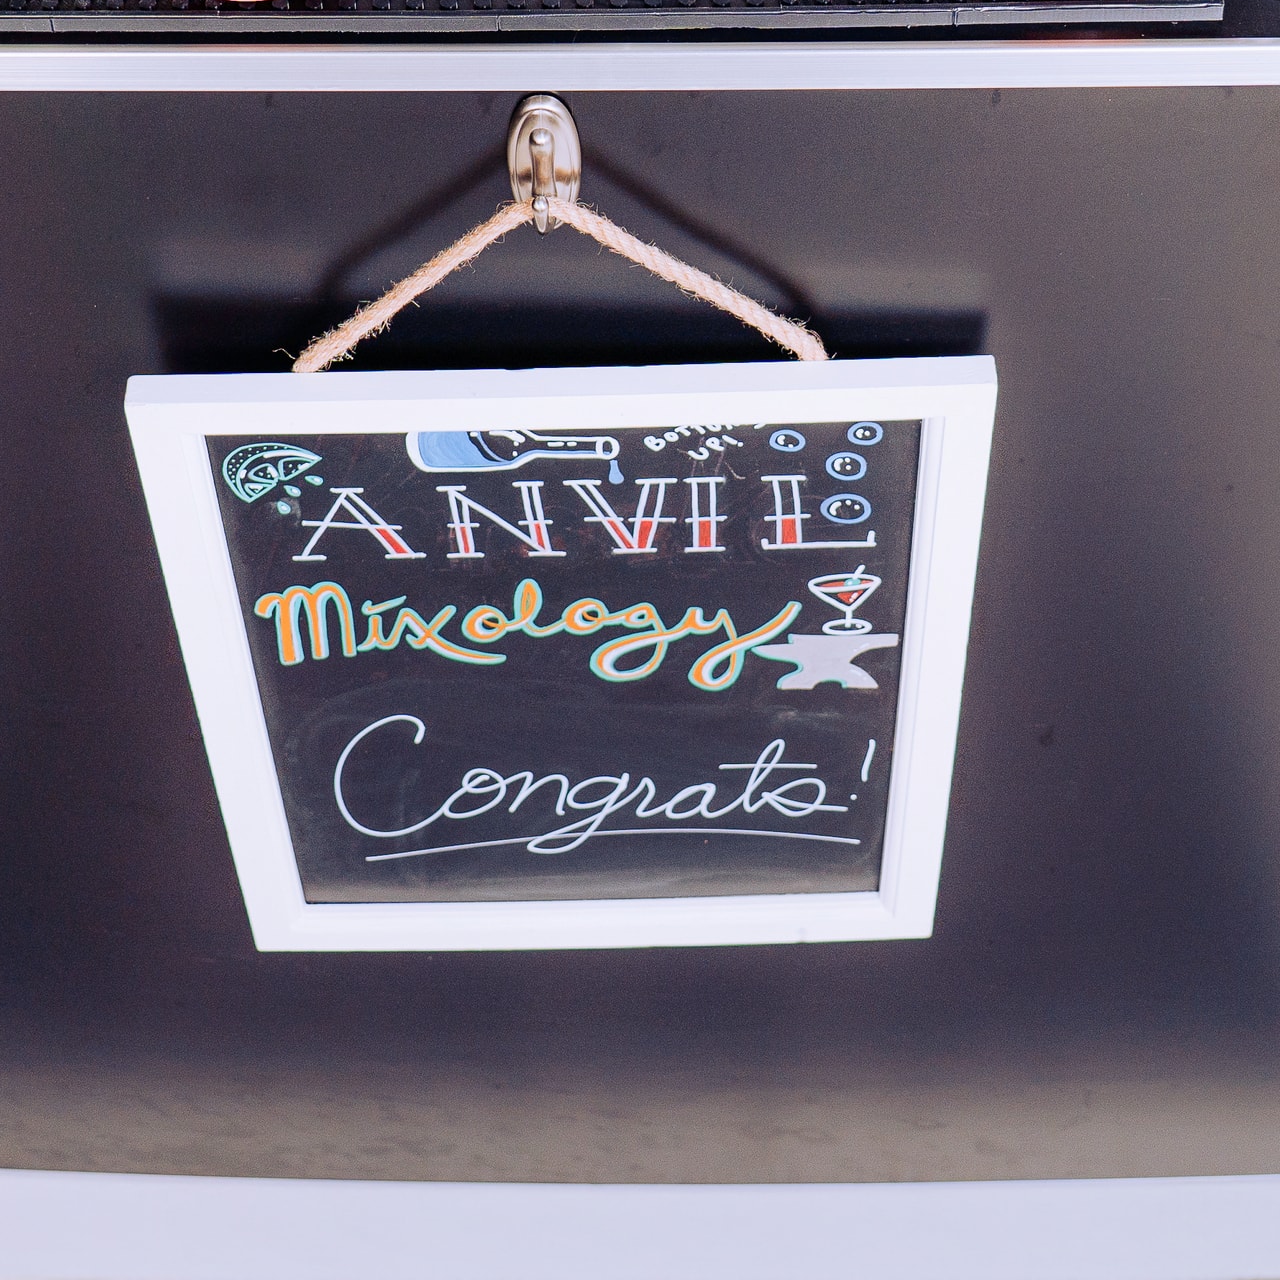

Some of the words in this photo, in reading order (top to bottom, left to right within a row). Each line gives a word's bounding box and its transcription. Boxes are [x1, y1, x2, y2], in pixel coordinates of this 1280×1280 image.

[687, 434, 744, 461] UP!
[293, 475, 876, 561] ANVIL
[254, 578, 802, 691] Mixology
[333, 714, 877, 854] Congrats!
